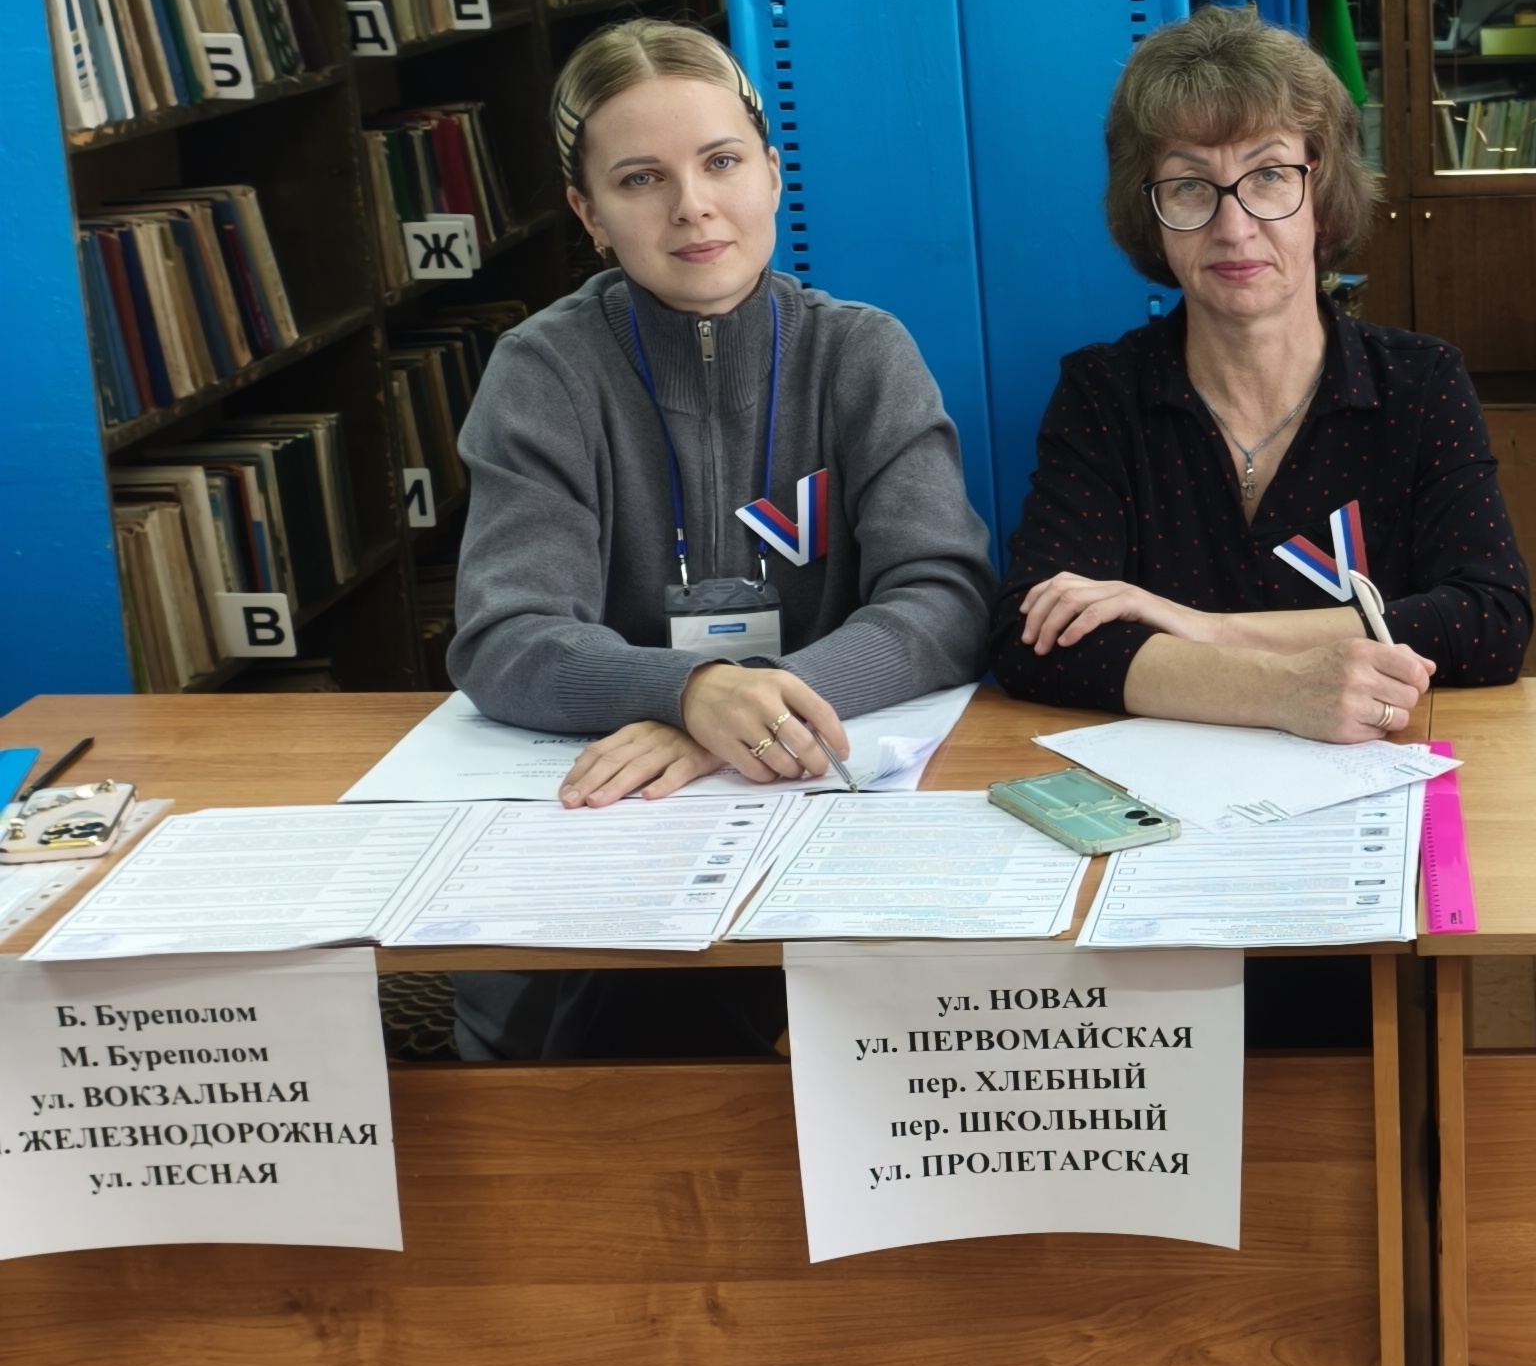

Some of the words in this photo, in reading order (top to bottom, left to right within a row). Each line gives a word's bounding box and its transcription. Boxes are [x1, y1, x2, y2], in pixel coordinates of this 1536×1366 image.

[348, 10, 389, 51] Д
[412, 232, 464, 270] Ж
[242, 605, 286, 647] В
[55, 1005, 87, 1027] Б.
[94, 1003, 258, 1032] Буреполом
[936, 995, 981, 1018] ул.
[988, 985, 1108, 1011] НОВАЯ
[59, 1046, 99, 1069] М.
[107, 1044, 270, 1072] Буреполом
[854, 1037, 899, 1061] ул.
[907, 1022, 1194, 1053] ПЕРВОМАЙСКАЯ
[30, 1093, 75, 1117] ул.
[82, 1080, 311, 1108] ВОКЗАЛЬНАЯ
[907, 1076, 967, 1099] пер.
[975, 1062, 1147, 1092] ХЛЕБНЫЙ
[18, 1121, 379, 1153] ЖЕЛЕЗНОДОРОЖНАЯ
[890, 1118, 949, 1142] пер.
[958, 1103, 1168, 1133] ШКОЛЬНЫЙ
[89, 1172, 133, 1195] ул.
[141, 1162, 280, 1188] ЛЕСНАЯ
[869, 1163, 912, 1191] ул.
[921, 1148, 1191, 1177] ПРОЛЕТАРСКАЯ
